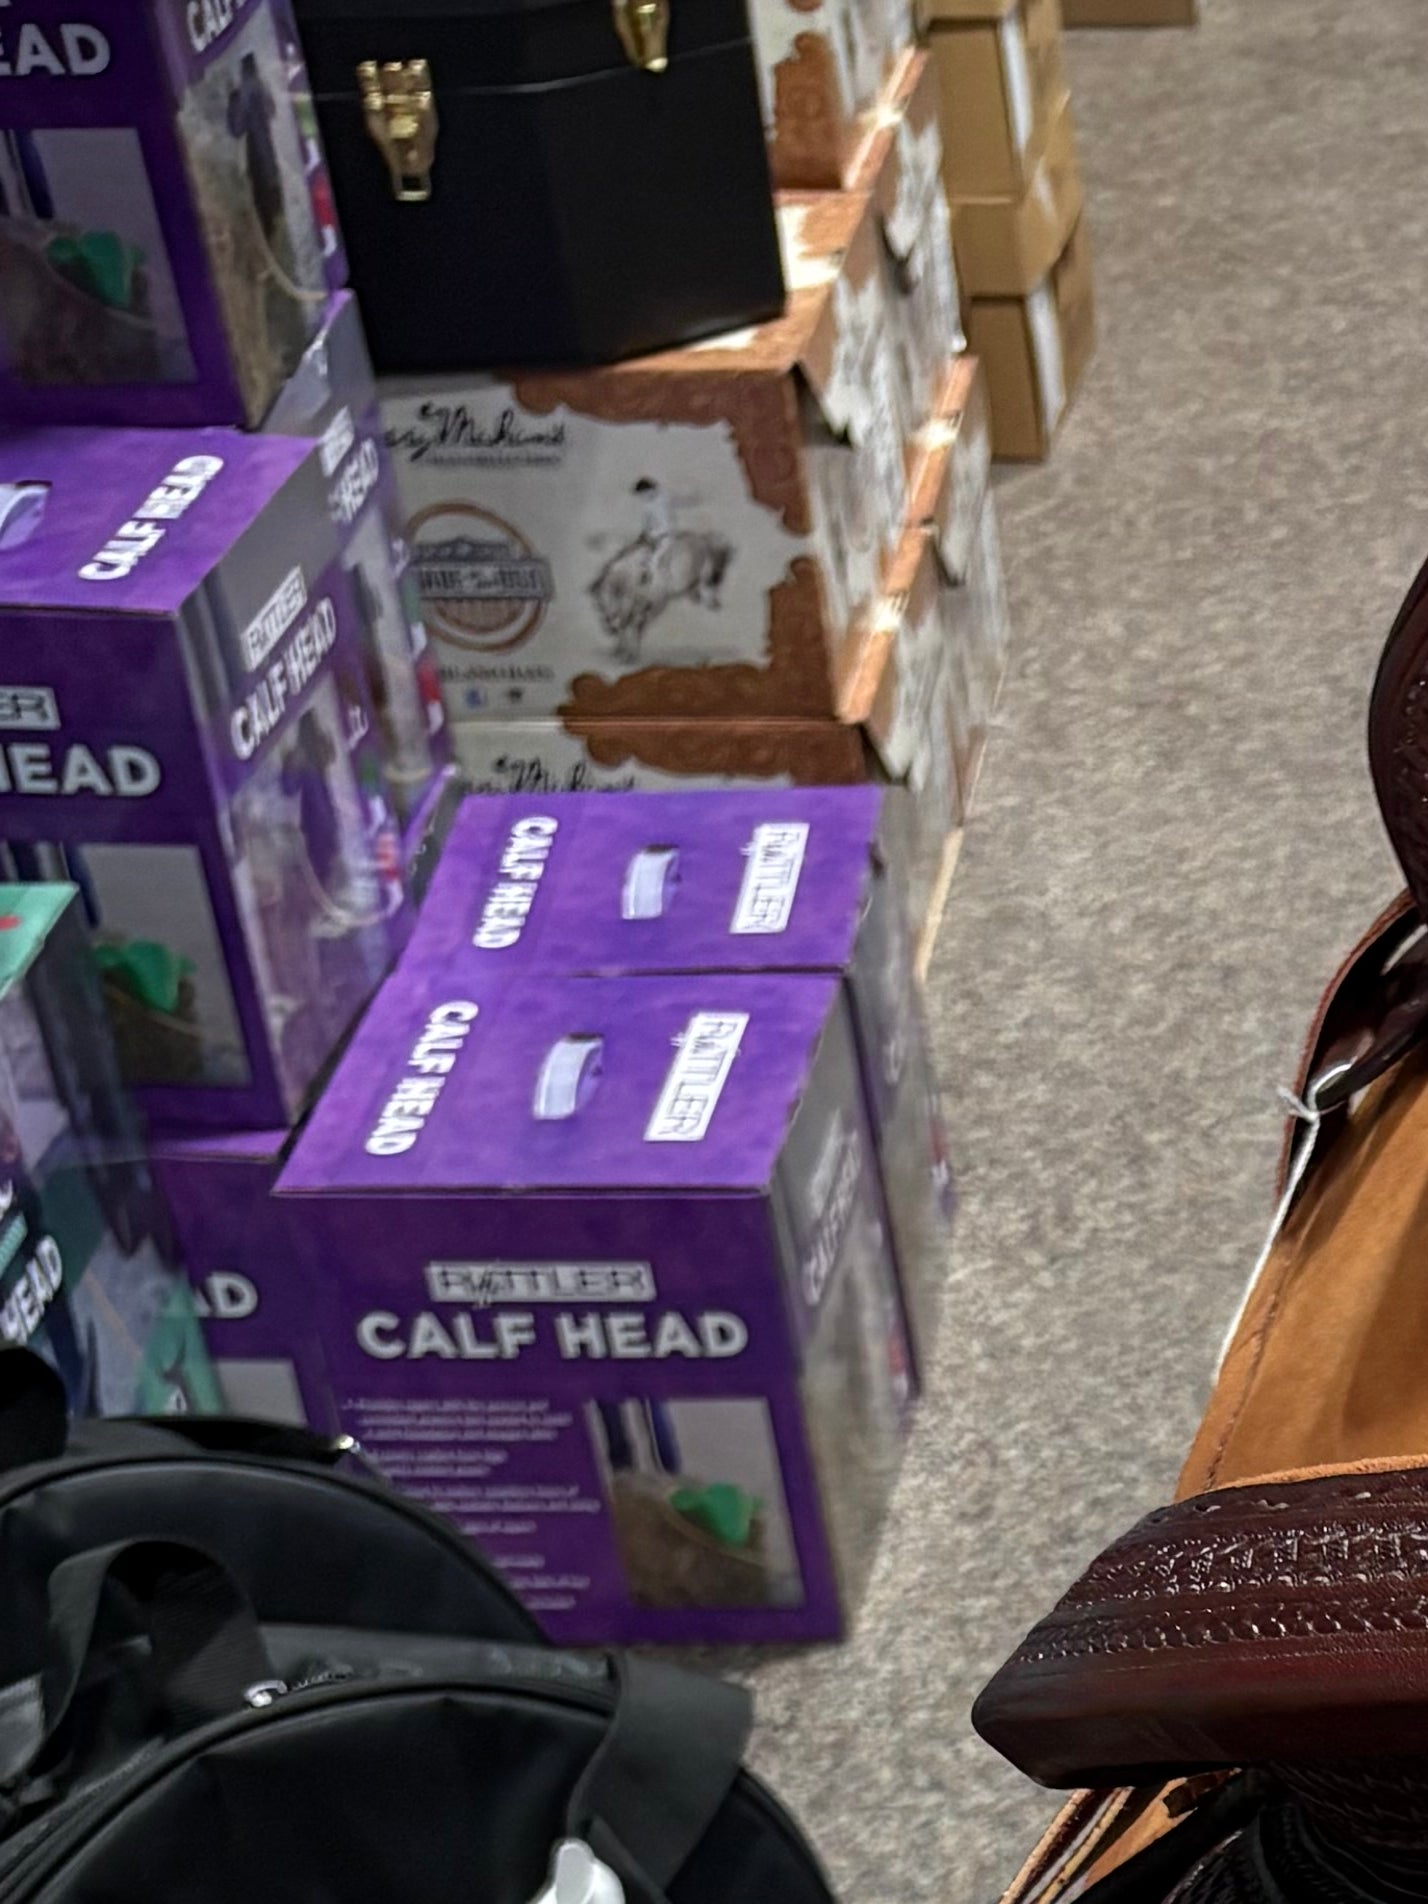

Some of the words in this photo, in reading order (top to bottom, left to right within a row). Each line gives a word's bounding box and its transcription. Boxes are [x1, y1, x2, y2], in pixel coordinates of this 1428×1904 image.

[78, 520, 166, 581] CALF
[131, 455, 224, 520] HEAD
[231, 661, 287, 760] CALF
[284, 596, 337, 696] HEAD
[0, 743, 162, 796] EAD
[498, 816, 559, 881] CALF
[472, 881, 538, 948] HEAD
[407, 1000, 479, 1074] CALF
[648, 1015, 743, 1139] RATTLER
[365, 1076, 447, 1155] HEAD
[431, 1263, 651, 1301] RATTLER
[357, 1310, 536, 1359] CALF
[555, 1310, 749, 1359] HEAD
